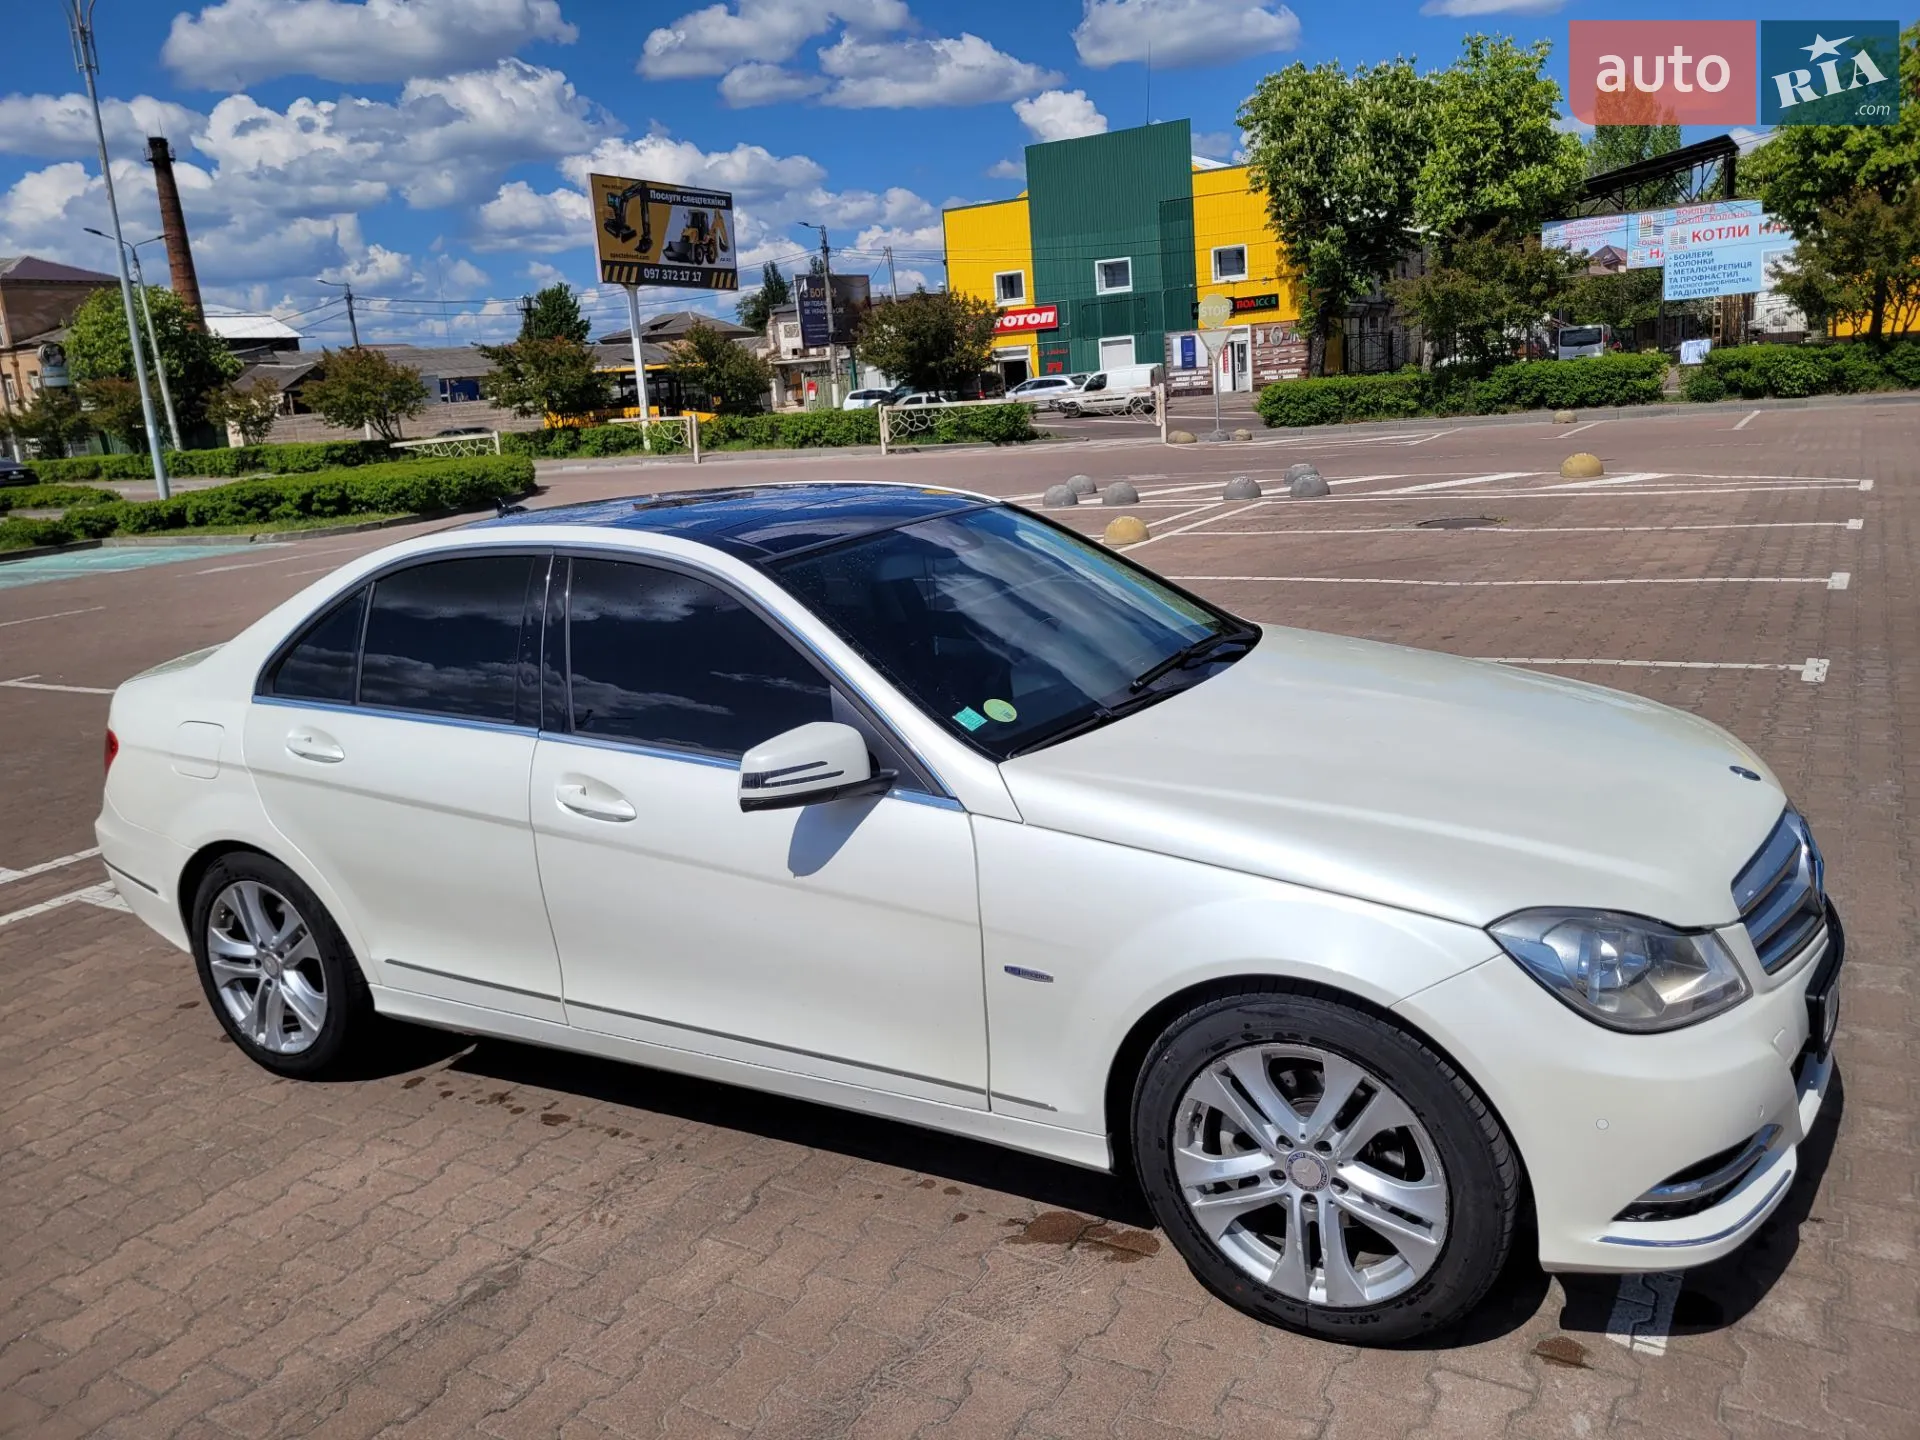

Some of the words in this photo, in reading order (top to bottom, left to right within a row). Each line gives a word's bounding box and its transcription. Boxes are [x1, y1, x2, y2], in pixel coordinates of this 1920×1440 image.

[650, 190, 680, 203] Послуги
[682, 194, 727, 207] спецтехніки
[1691, 224, 1750, 243] КОТЛИ
[1673, 250, 1713, 261] БОЙЛЕРИ
[1673, 258, 1715, 269] КОЛОНКИ
[1673, 262, 1753, 276] МЕТАЛОЧЕРЕПИЦЯ
[643, 268, 660, 279] 097
[661, 269, 679, 280] 372
[680, 271, 691, 281] 17
[692, 272, 702, 282] 17
[1668, 276, 1680, 285] ТА
[1681, 271, 1739, 283] ПРОФНАСТИЛ
[1673, 286, 1720, 297] РАДІАТОРИ
[1201, 305, 1229, 318] STOP
